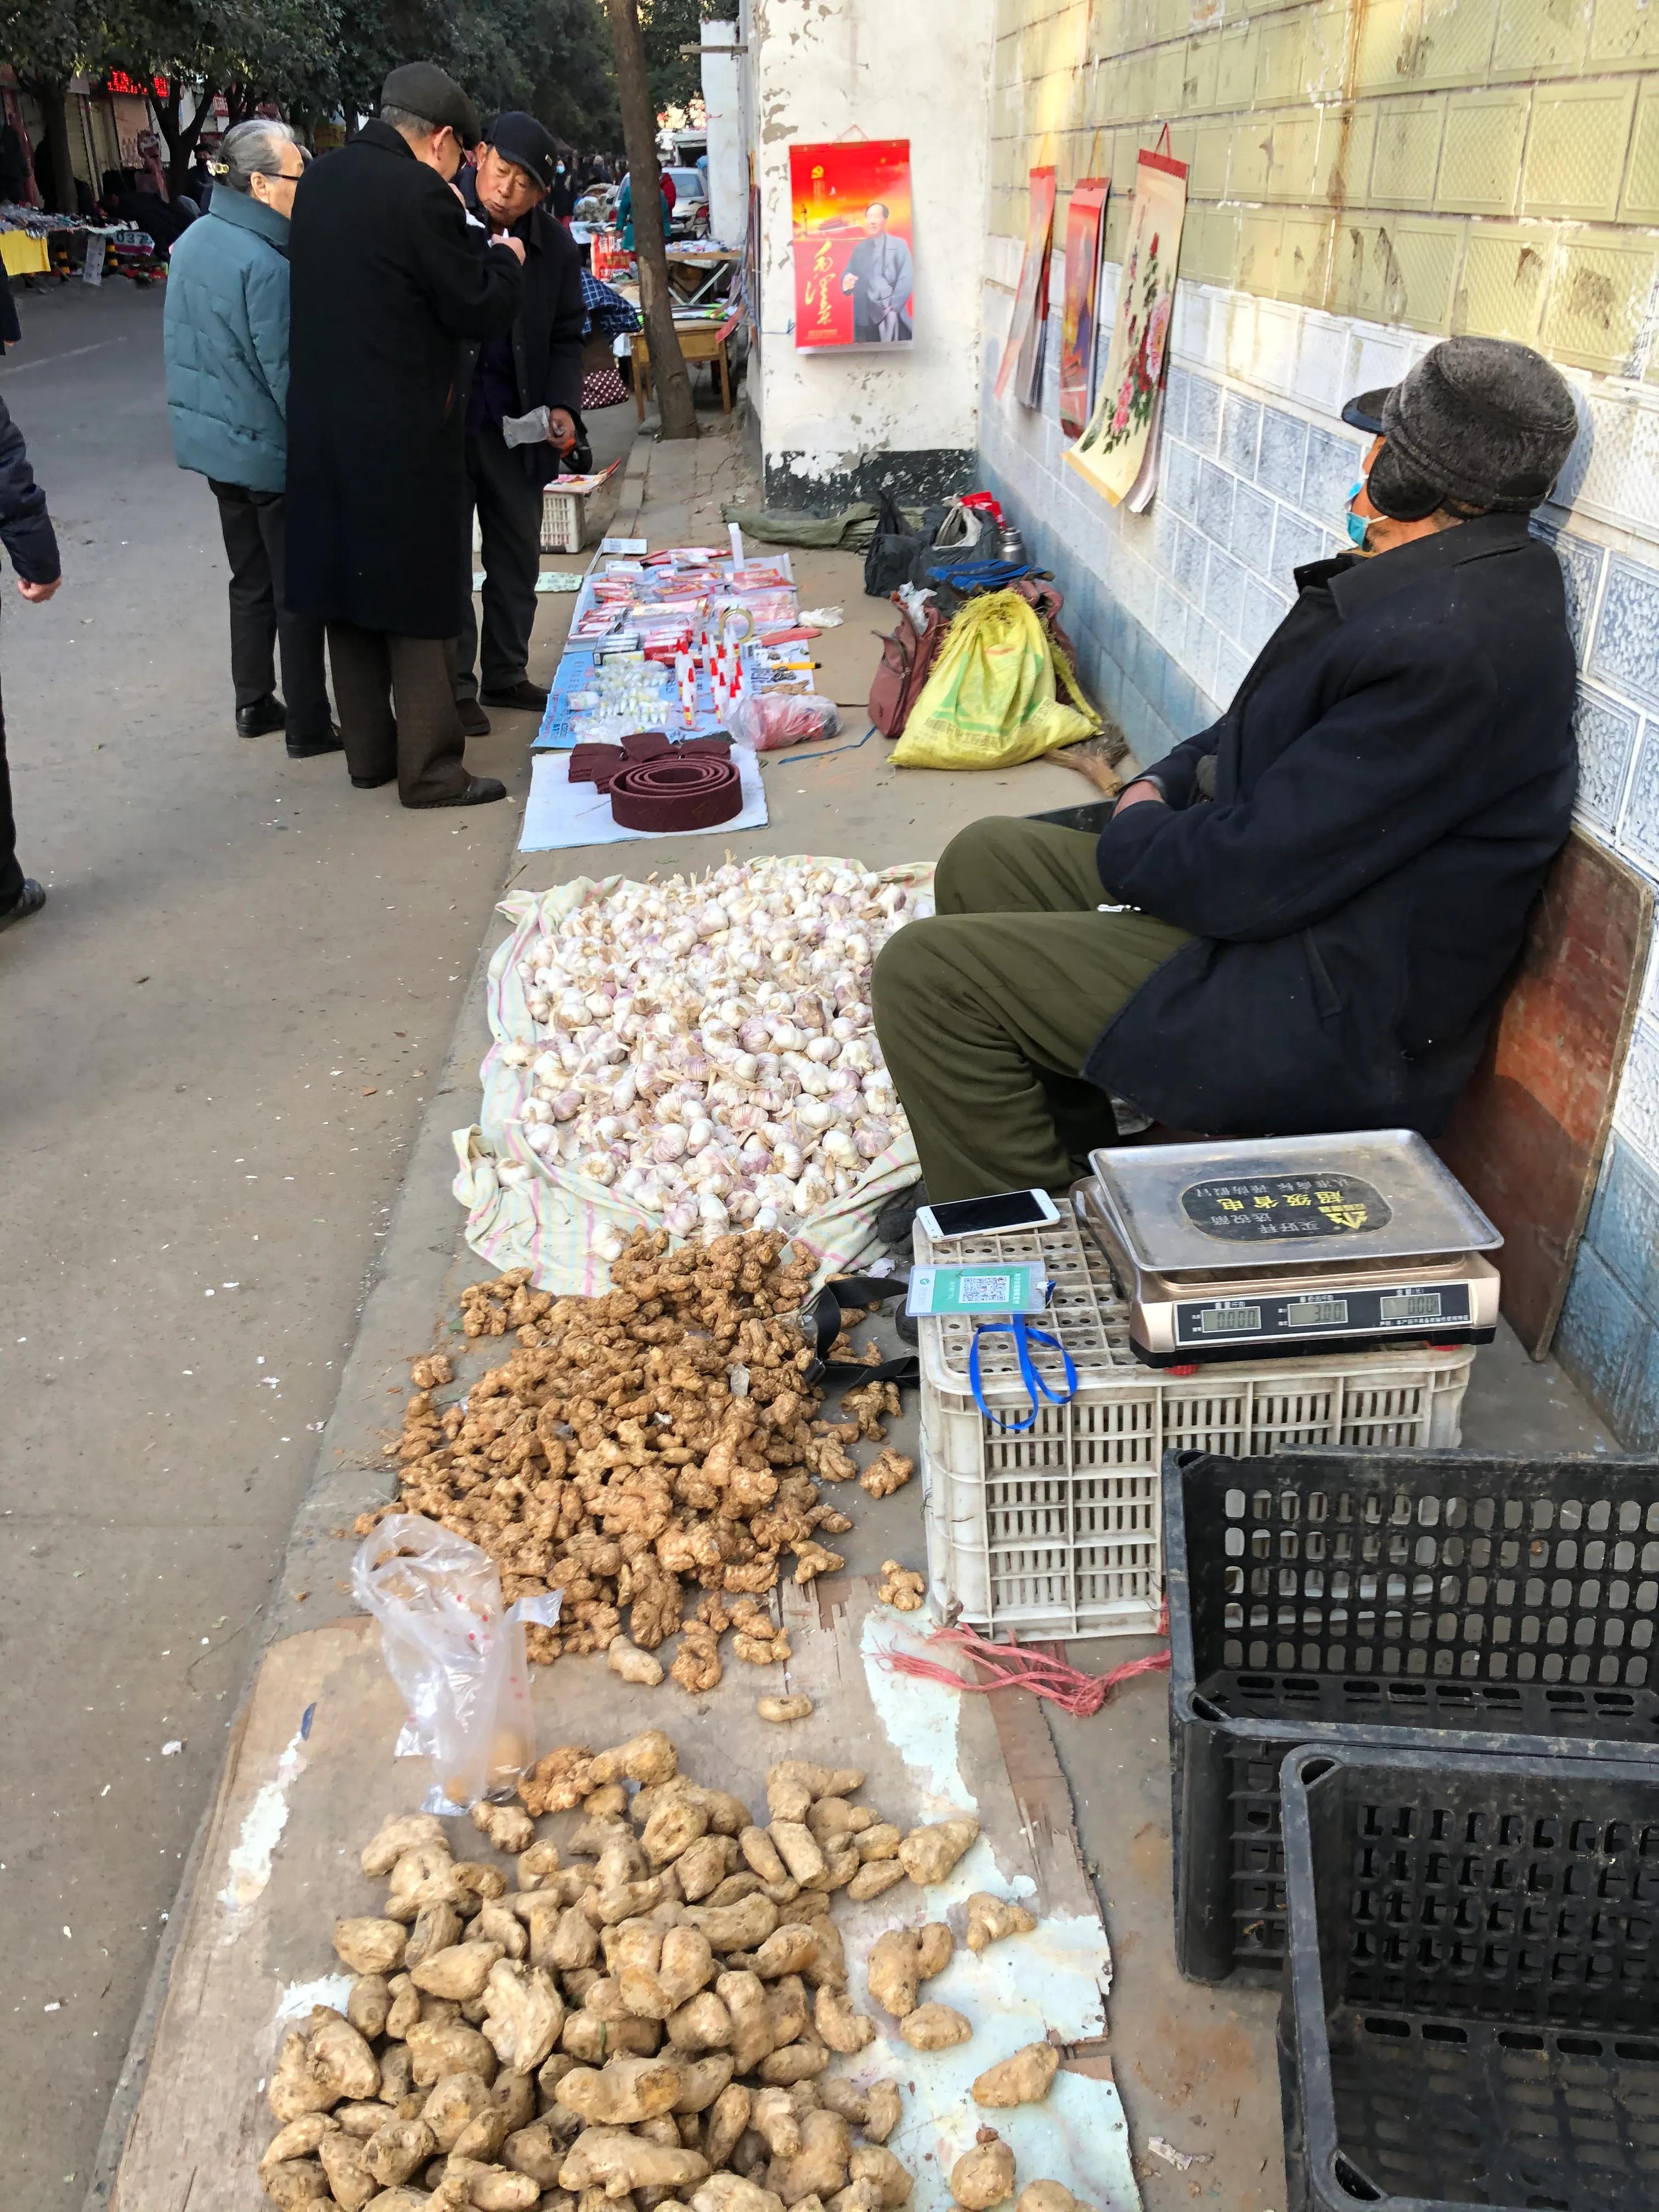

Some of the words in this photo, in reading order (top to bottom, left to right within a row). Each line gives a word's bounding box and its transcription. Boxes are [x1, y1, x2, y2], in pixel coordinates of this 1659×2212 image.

[1215, 1190, 1345, 1211] 超级省电
[1257, 1220, 1320, 1234] 买好秤
